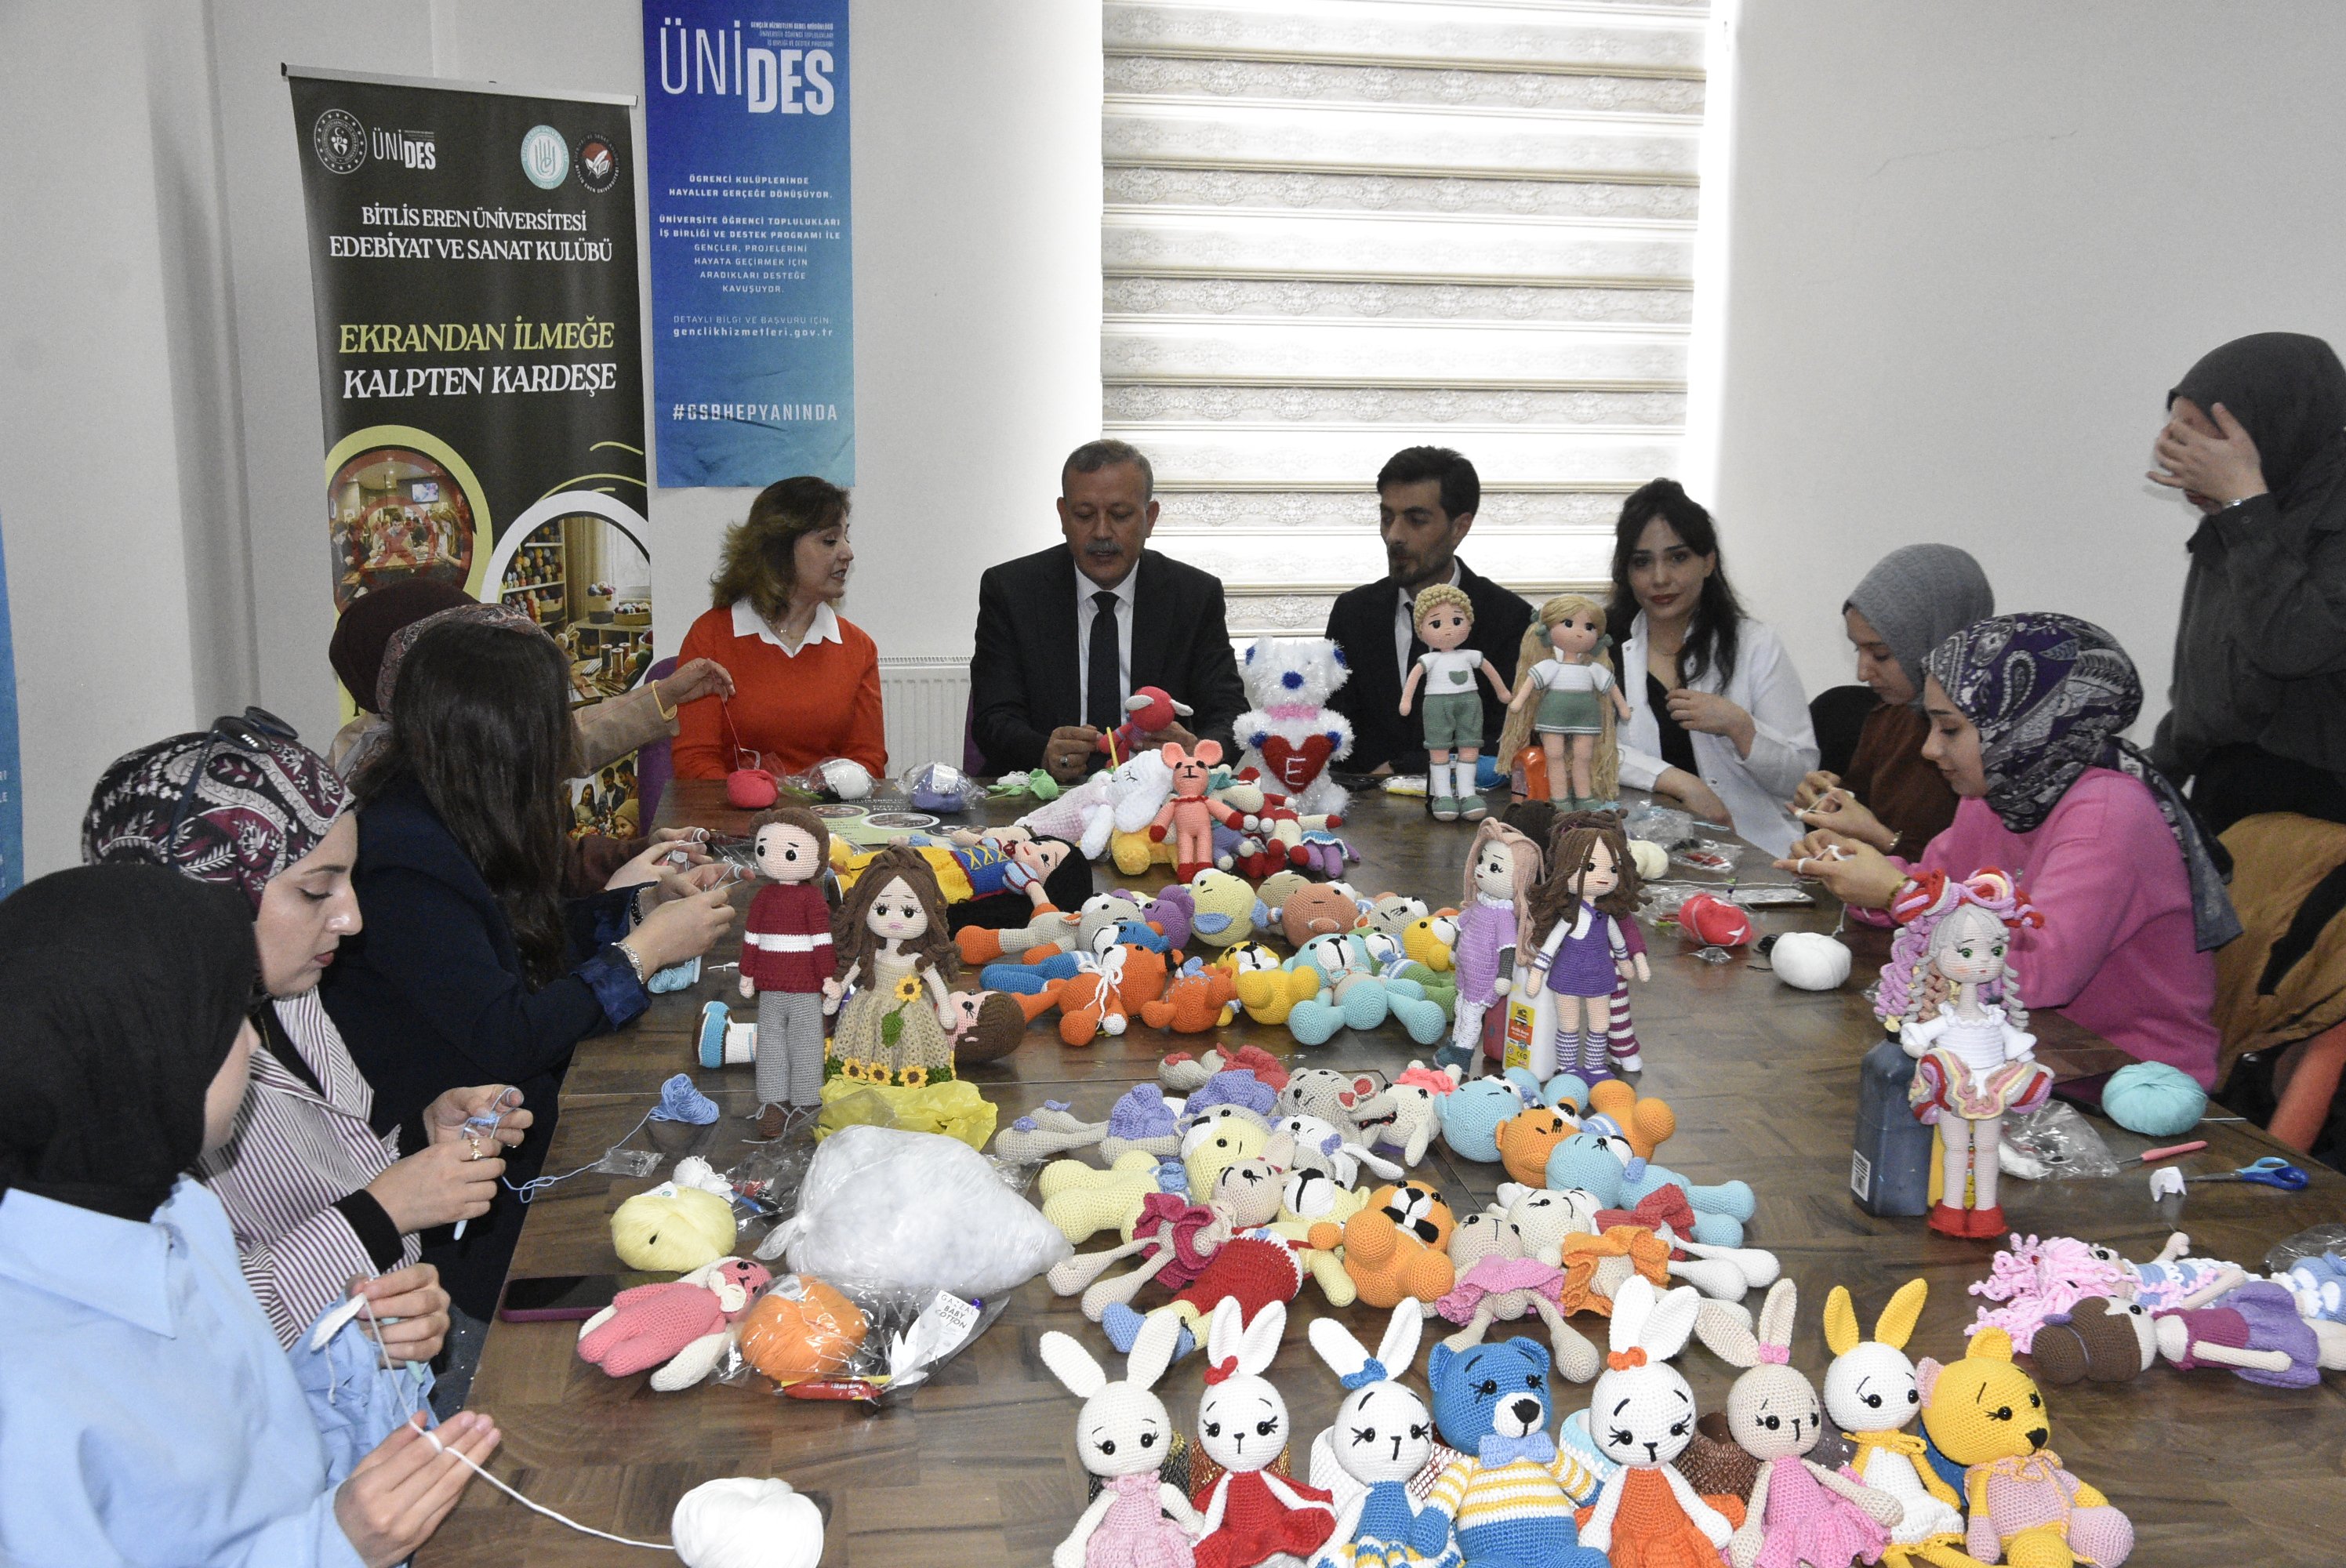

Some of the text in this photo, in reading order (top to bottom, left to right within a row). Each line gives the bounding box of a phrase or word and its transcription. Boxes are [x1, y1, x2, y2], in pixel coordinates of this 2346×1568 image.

[735, 176, 809, 184] KULÜPLERİNDE
[669, 188, 833, 200] HAYALLER GERÇEĞE DÖNÜŞÜYOR.
[361, 201, 587, 231] BİTLİS EREN ÜNİVERSİTESİ
[659, 213, 841, 226] ÜNİVERSİTE ÖĞRENCİ TOPLULUKLARI
[659, 228, 670, 238] İŞ
[673, 228, 710, 238] BİRLİĞİ
[729, 230, 767, 239] DESTEK
[826, 230, 841, 239] İLE
[329, 231, 612, 262] EDEBİYAT VE SANAT KULÜBÜ
[694, 244, 741, 252] GENÇLER,
[735, 257, 785, 267] GEÇİRMEK
[699, 270, 806, 280] ARADIKLARI DESTEĞE
[722, 285, 784, 295] KAVUŞUYOR.
[761, 316, 806, 325] BAŞVURU
[339, 315, 615, 354] EKRANDAN İLMEĞE
[673, 326, 833, 339] genclikhizmetleri.gov.tr
[343, 363, 617, 399] KALPTEN KARDEŞE
[672, 403, 838, 421] #GSBHEPYANINDA
[1284, 757, 1307, 786] E
[940, 1294, 975, 1316] GAZZAL
[943, 1305, 965, 1319] BABY
